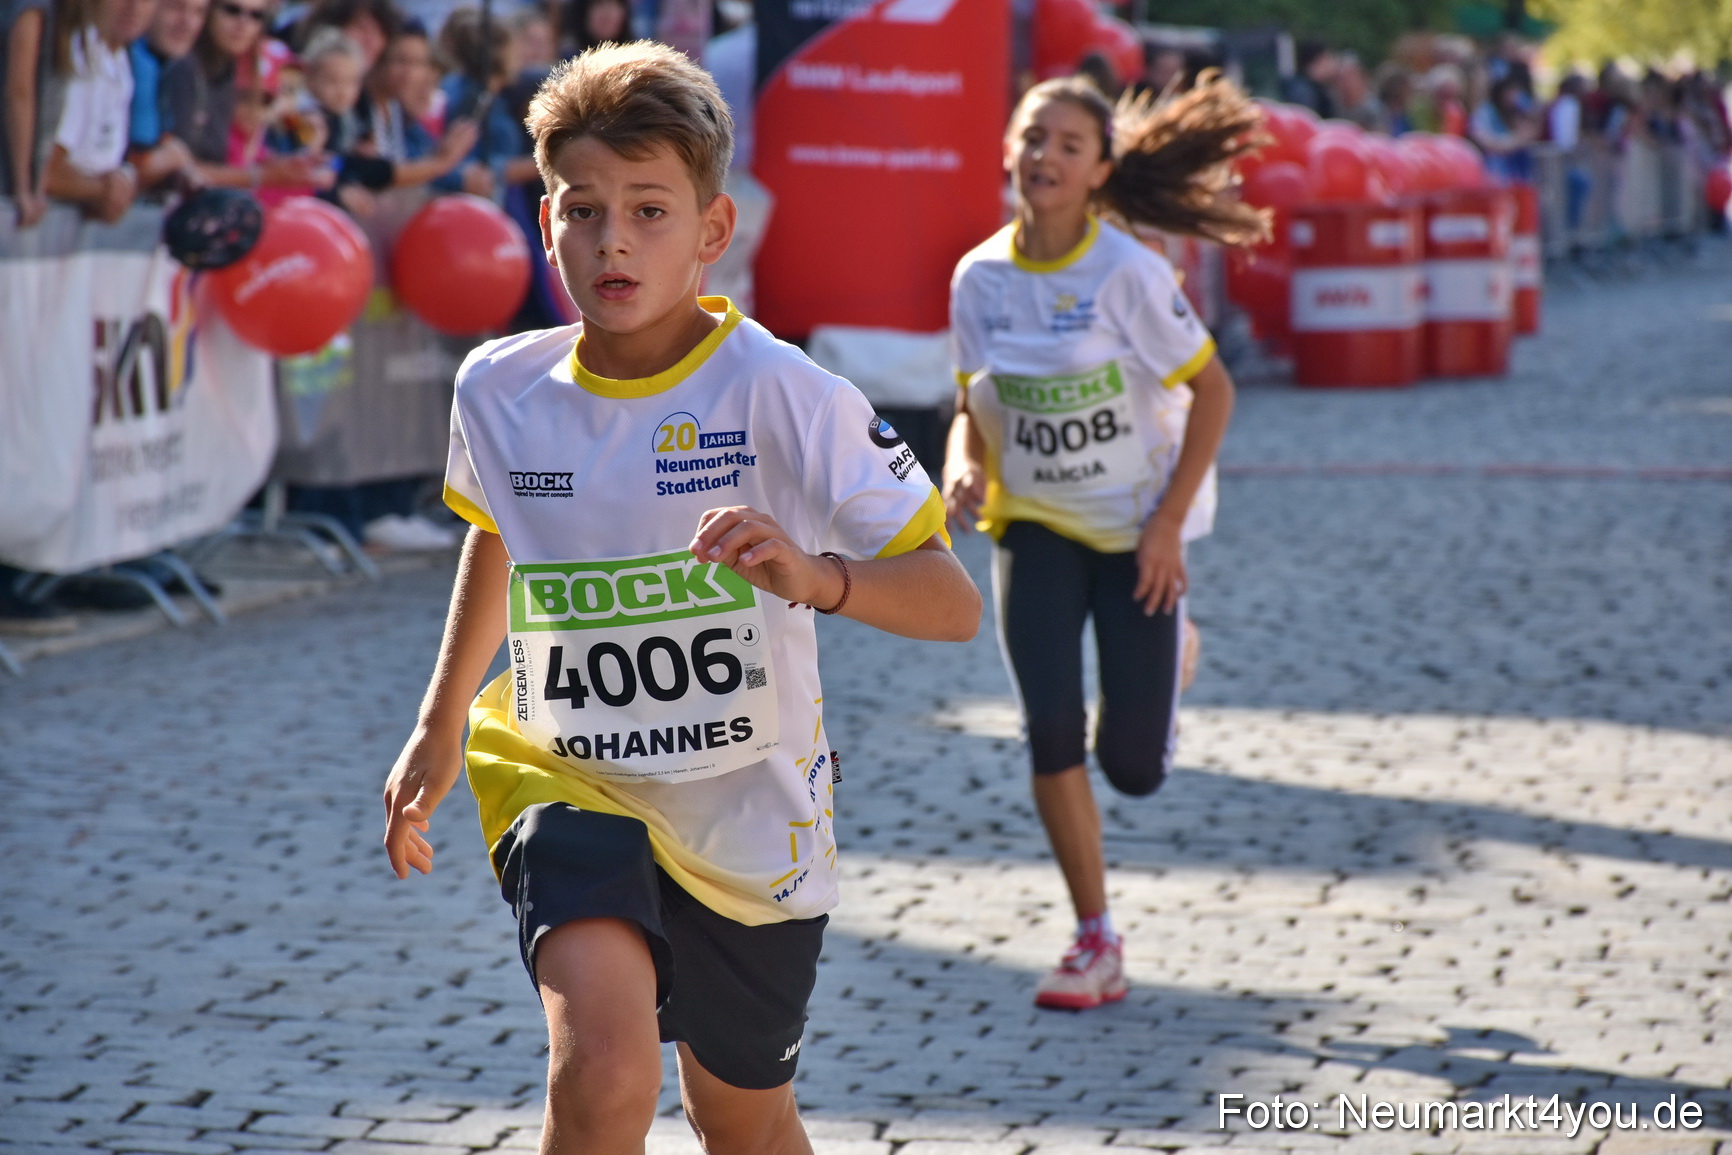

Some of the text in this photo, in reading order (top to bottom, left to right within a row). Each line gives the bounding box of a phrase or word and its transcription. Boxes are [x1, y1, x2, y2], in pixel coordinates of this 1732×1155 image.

[657, 422, 743, 453] 20 JAHRE
[1015, 409, 1118, 457] 4008
[655, 451, 757, 474] Neumarkter
[1033, 461, 1107, 484] ALICIA
[509, 471, 574, 491] BOCK
[656, 469, 741, 496] Stadtlauf
[528, 561, 724, 618] BOCK
[743, 628, 754, 642] J
[544, 627, 744, 710] 4006
[551, 716, 754, 761] JOHANNES
[808, 754, 826, 786] 2019
